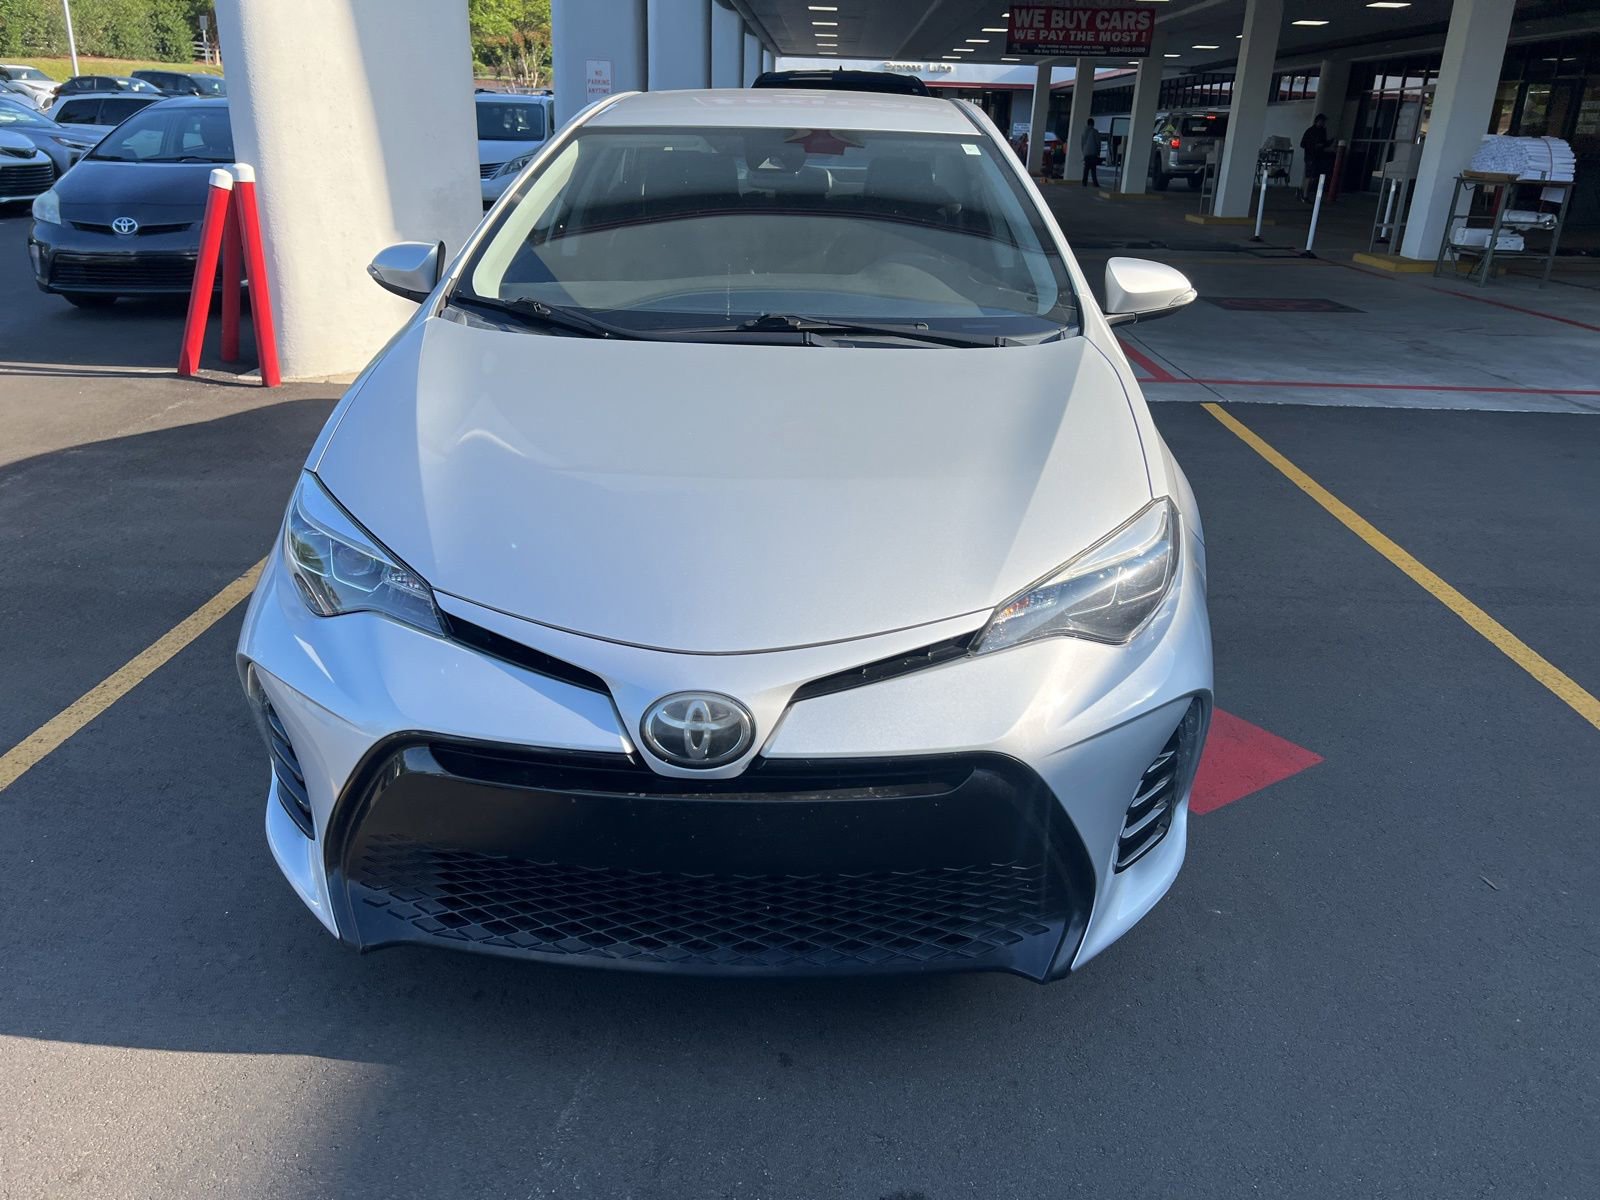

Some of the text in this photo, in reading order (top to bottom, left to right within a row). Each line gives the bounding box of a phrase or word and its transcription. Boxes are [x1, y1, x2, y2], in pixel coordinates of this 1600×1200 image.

[1014, 8, 1150, 30] WE BUY CARS
[1014, 29, 1036, 40] WE
[1039, 30, 1067, 41] PAY
[1069, 31, 1095, 41] THE
[1099, 32, 1138, 42] MOST
